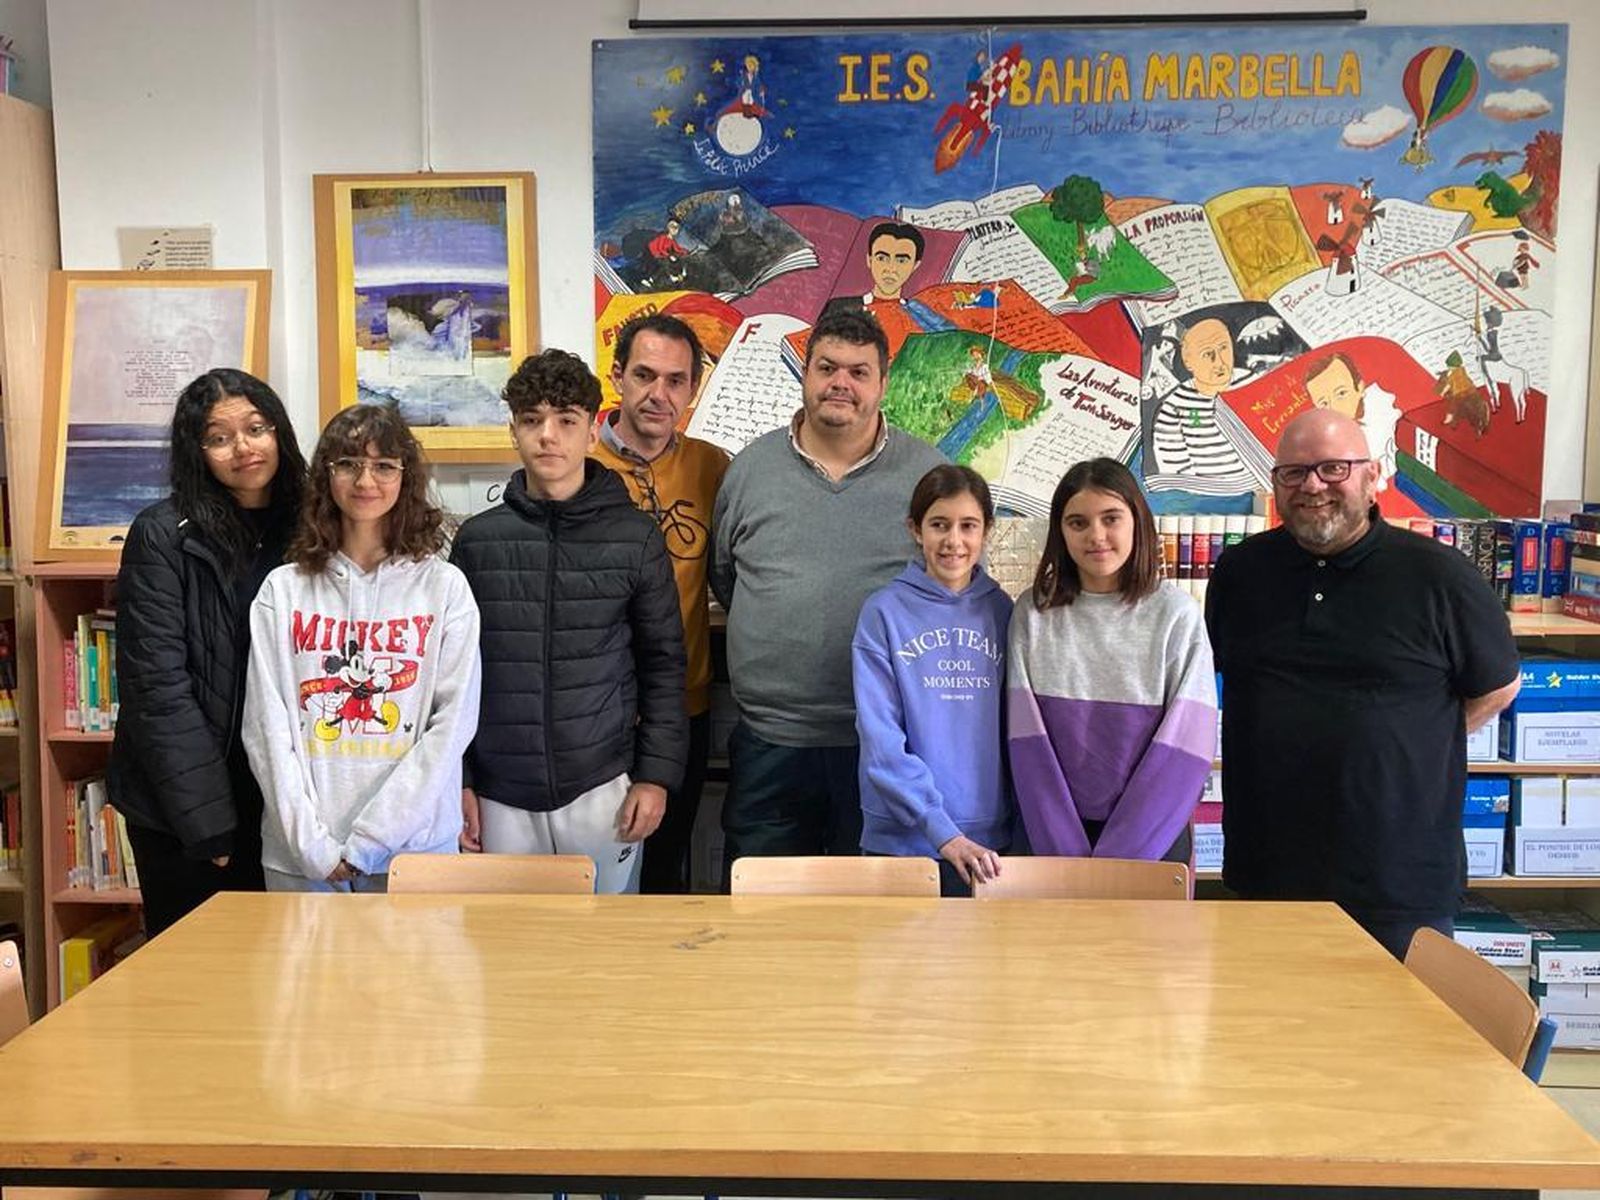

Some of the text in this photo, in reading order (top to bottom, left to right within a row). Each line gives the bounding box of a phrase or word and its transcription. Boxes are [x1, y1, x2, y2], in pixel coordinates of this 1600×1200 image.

[838, 50, 1362, 106] I.E.S. BAHÍA MARBELLA
[1125, 223, 1142, 241] LA
[739, 323, 762, 344] F
[1057, 362, 1138, 406] Las Aventuras
[1060, 386, 1078, 401] de
[1095, 404, 1136, 431] Sawyer
[486, 483, 500, 502] C
[292, 610, 435, 657] MICKEY
[896, 627, 1003, 667] NICE TEAM
[937, 660, 975, 672] COOL
[923, 676, 991, 689] MOMENTS
